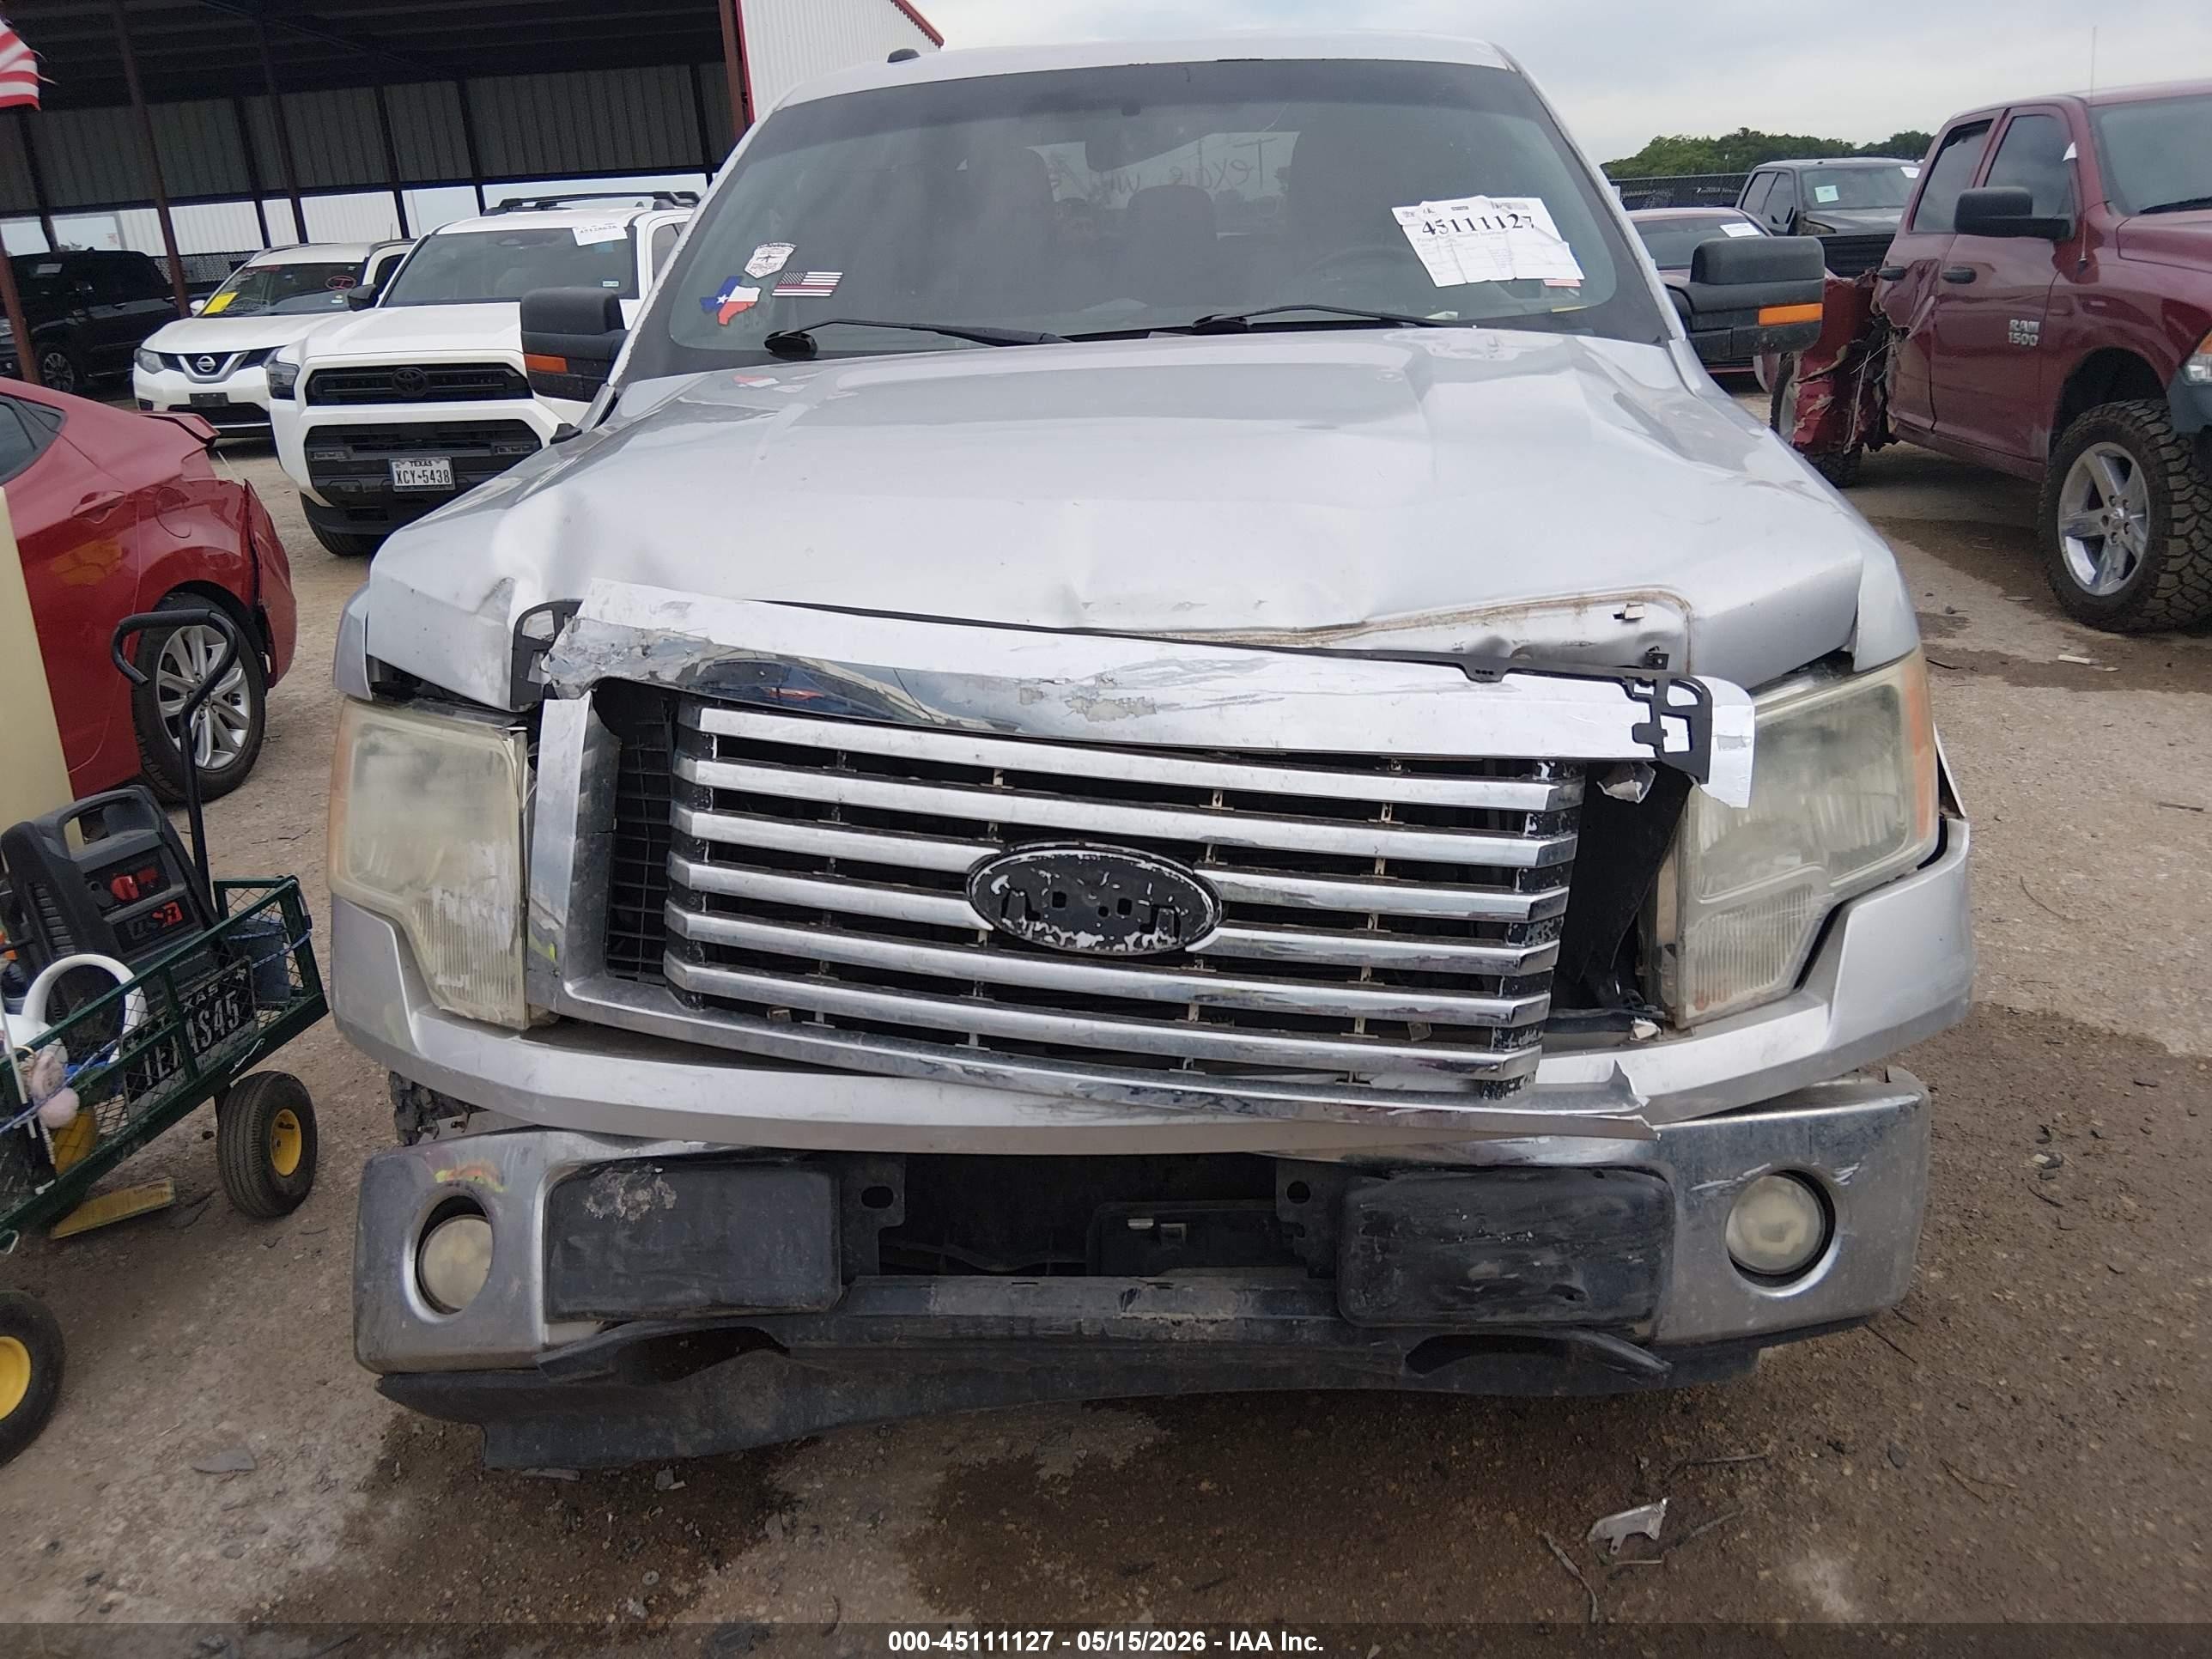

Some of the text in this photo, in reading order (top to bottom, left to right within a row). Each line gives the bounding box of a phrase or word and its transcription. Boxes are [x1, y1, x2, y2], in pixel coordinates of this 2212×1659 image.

[1422, 213, 1534, 236] 45111127
[2008, 319, 2041, 333] RAM
[2008, 331, 2039, 347] 1500
